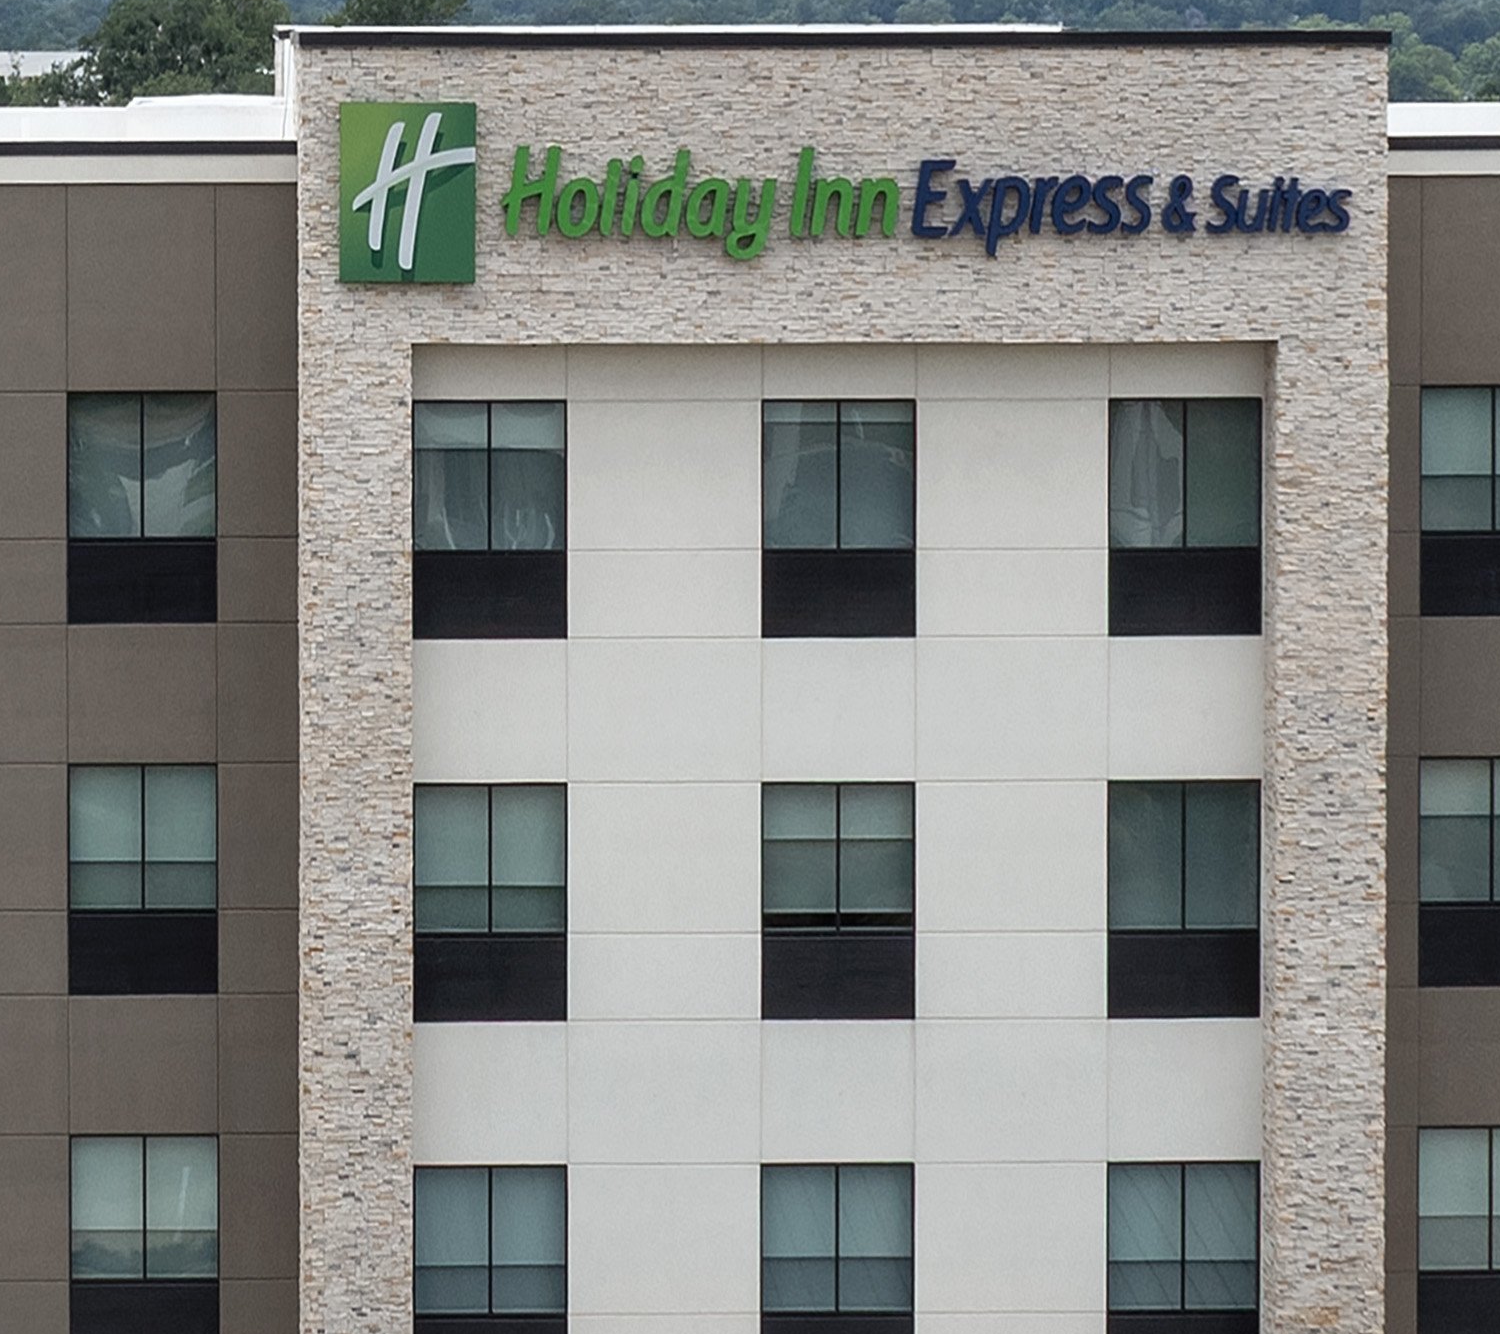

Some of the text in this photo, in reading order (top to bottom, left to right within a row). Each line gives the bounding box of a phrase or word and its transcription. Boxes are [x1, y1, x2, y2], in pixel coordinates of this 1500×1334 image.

[502, 145, 1352, 260] Holiday Inn Express & Suites
